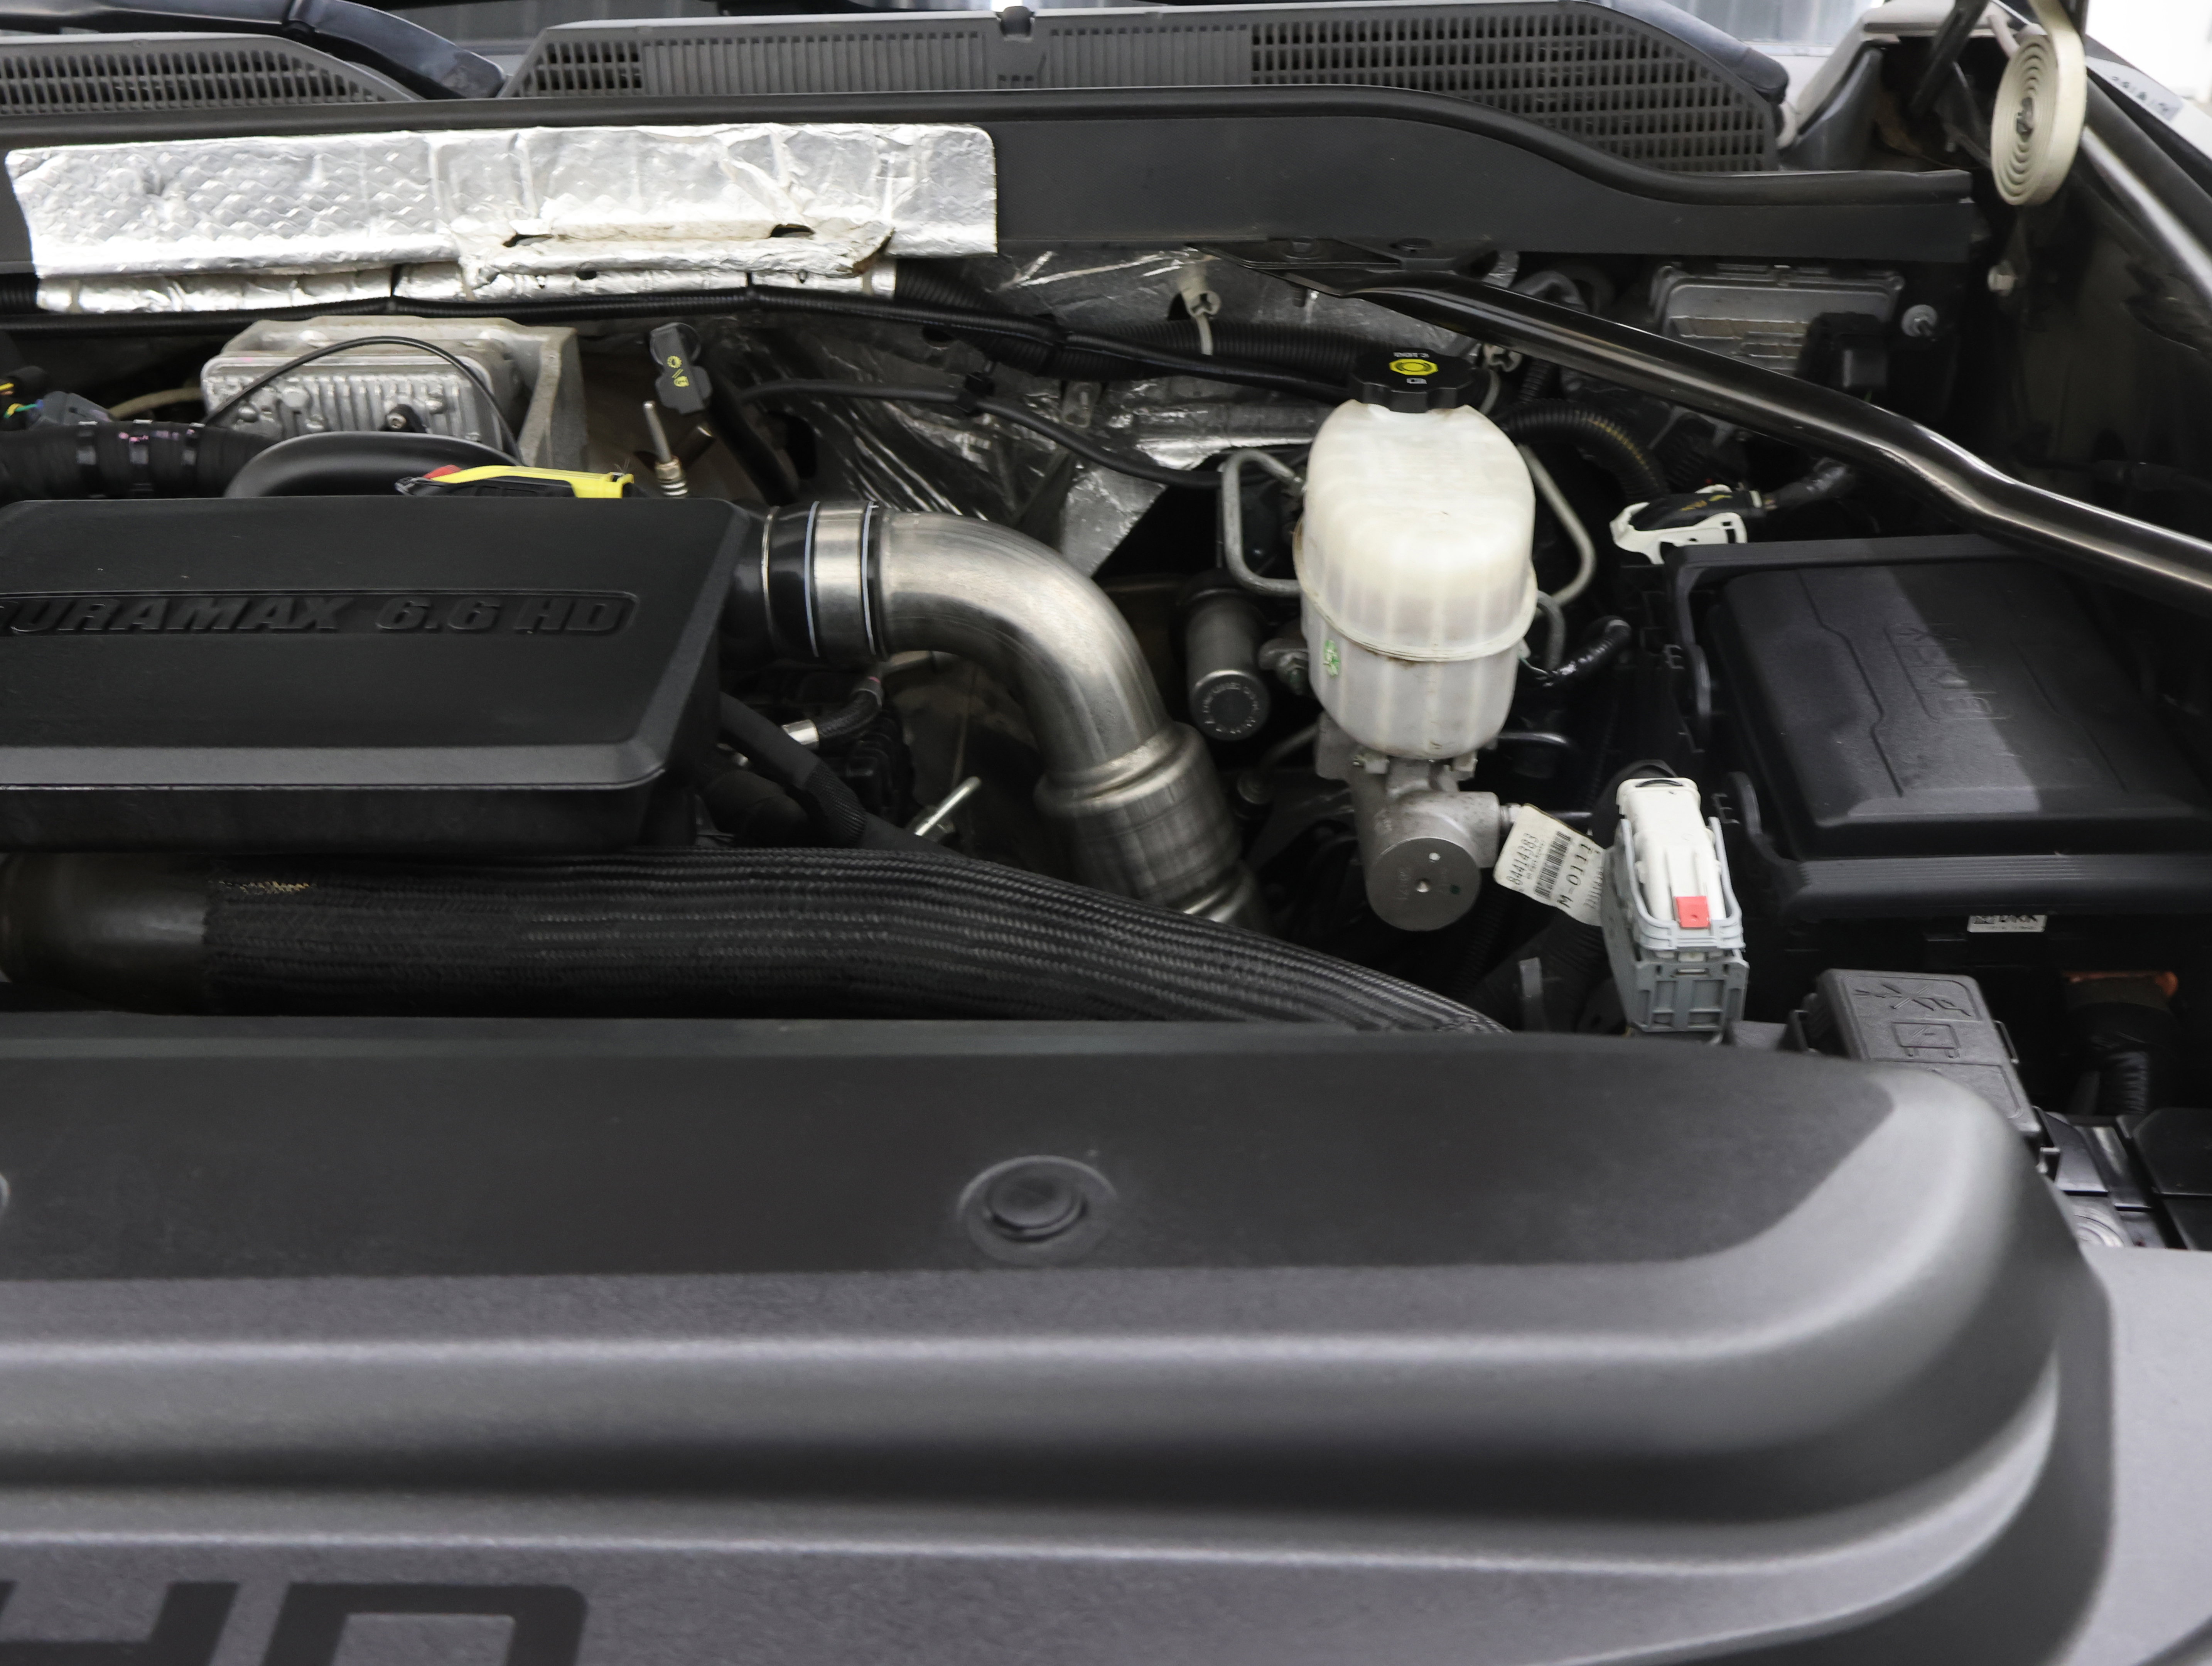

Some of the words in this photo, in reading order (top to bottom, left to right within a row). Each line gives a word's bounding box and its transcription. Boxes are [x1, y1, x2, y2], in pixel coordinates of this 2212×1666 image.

[376, 596, 501, 632] 6.6
[514, 597, 626, 634] HD
[1506, 833, 1539, 886] 84414383
